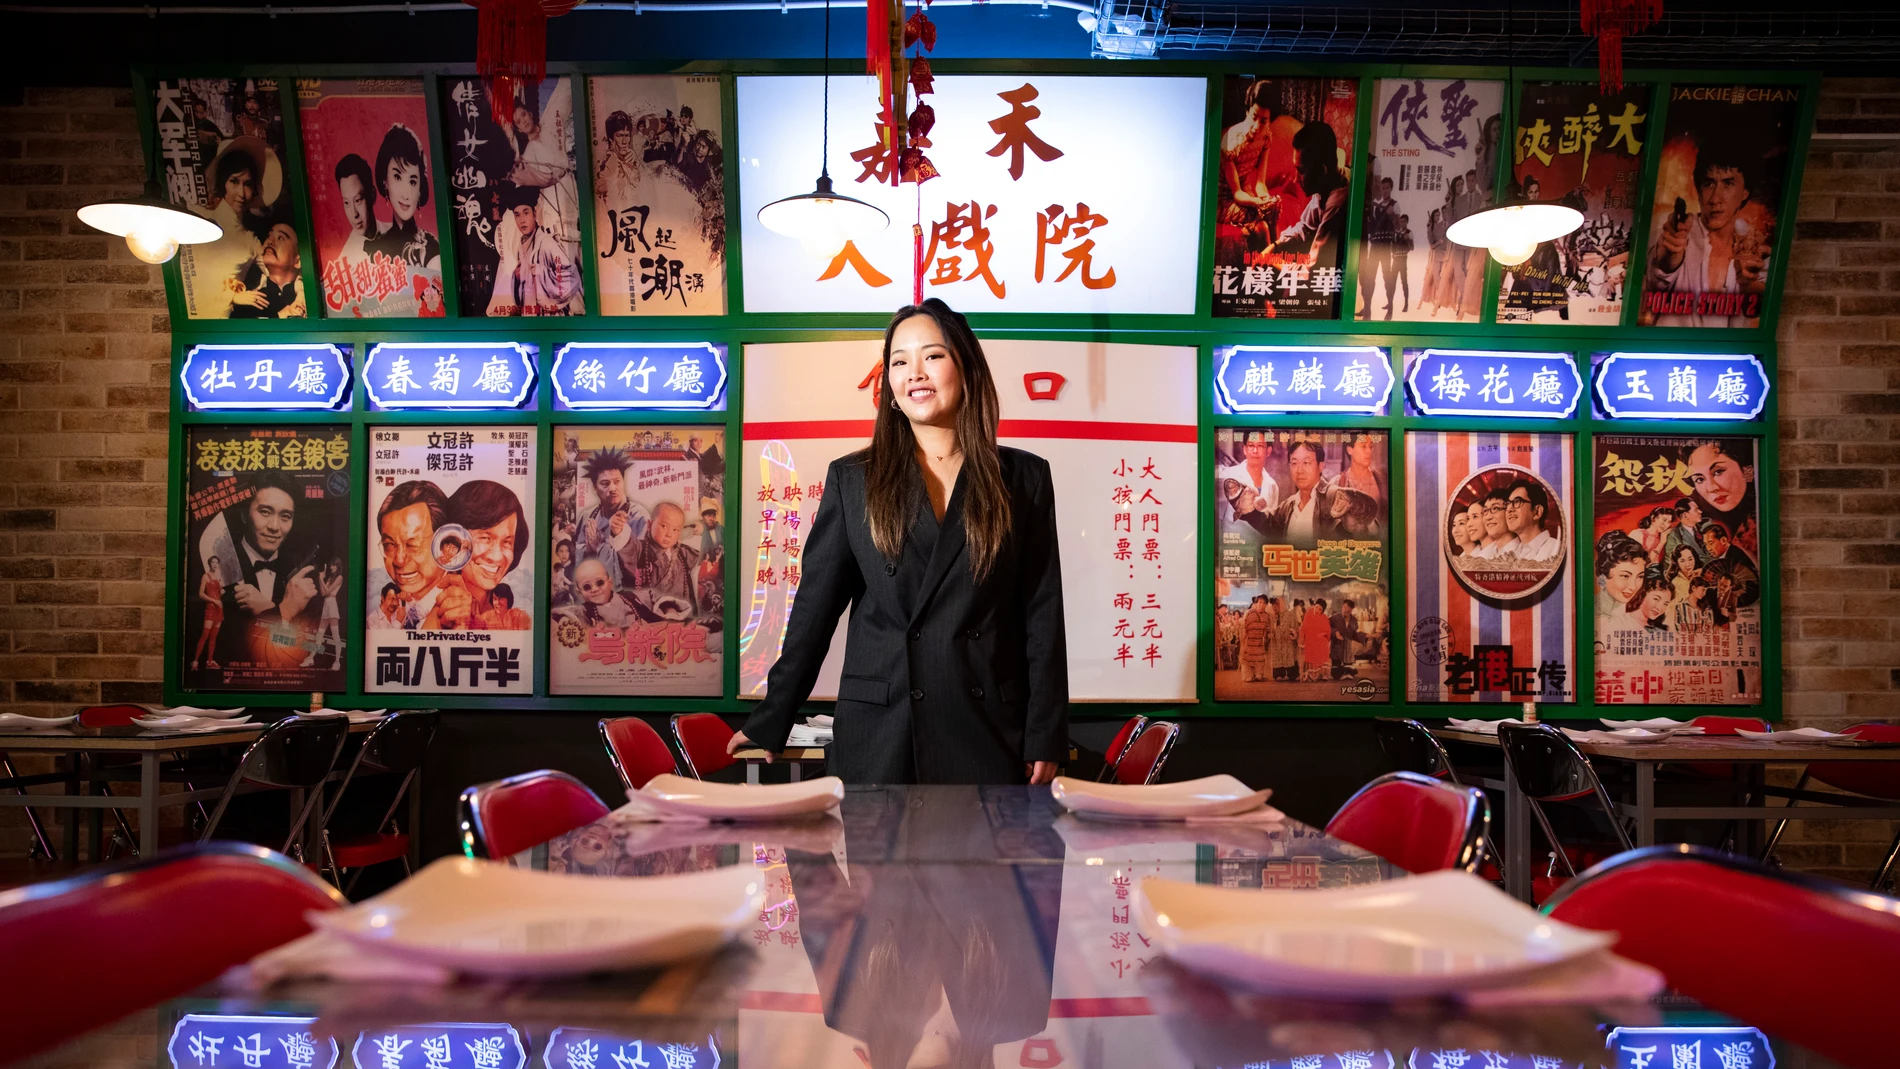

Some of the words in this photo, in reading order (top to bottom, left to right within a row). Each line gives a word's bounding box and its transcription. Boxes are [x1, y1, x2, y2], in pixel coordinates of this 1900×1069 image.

[1671, 87, 1731, 102] JACKIE
[1747, 88, 1799, 103] CHAN
[1382, 149, 1396, 157] THE
[1398, 149, 1420, 157] STING
[1213, 265, 1342, 296] 花樣年華
[1643, 291, 1695, 315] POLICE
[1697, 292, 1745, 316] STORY
[1746, 294, 1758, 316] 2
[200, 357, 328, 394] 牡丹廳
[382, 354, 513, 395] 春菊廳
[572, 355, 705, 394] 絲竹廳
[1238, 356, 1375, 400] 麒麟廳
[1430, 362, 1564, 405] 梅花廳
[1618, 365, 1750, 406] 玉蘭廳
[406, 631, 426, 641] The
[426, 631, 465, 641] Private
[466, 632, 491, 643] Eyes
